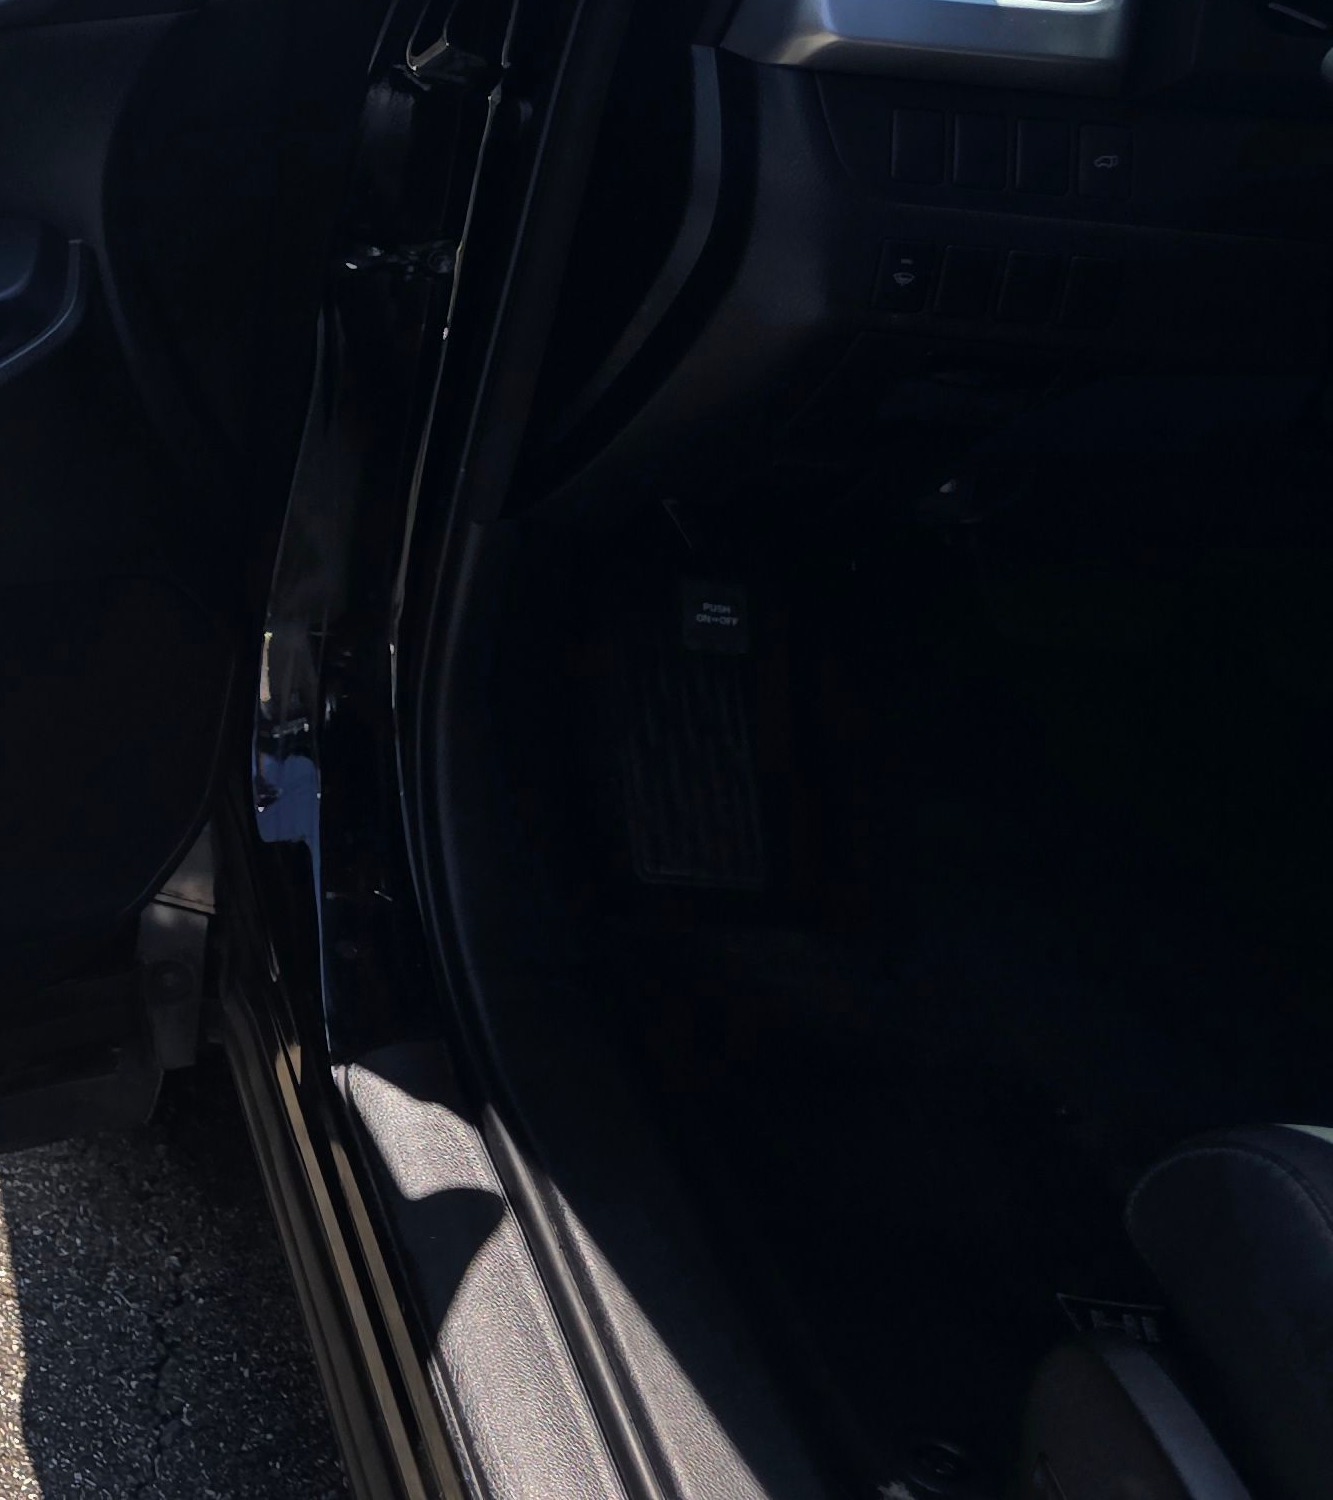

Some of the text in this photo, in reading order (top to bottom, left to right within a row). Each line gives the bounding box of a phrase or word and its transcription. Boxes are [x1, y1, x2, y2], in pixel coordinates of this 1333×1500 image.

[702, 602, 731, 612] PUSH
[696, 614, 738, 626] ON OFF
